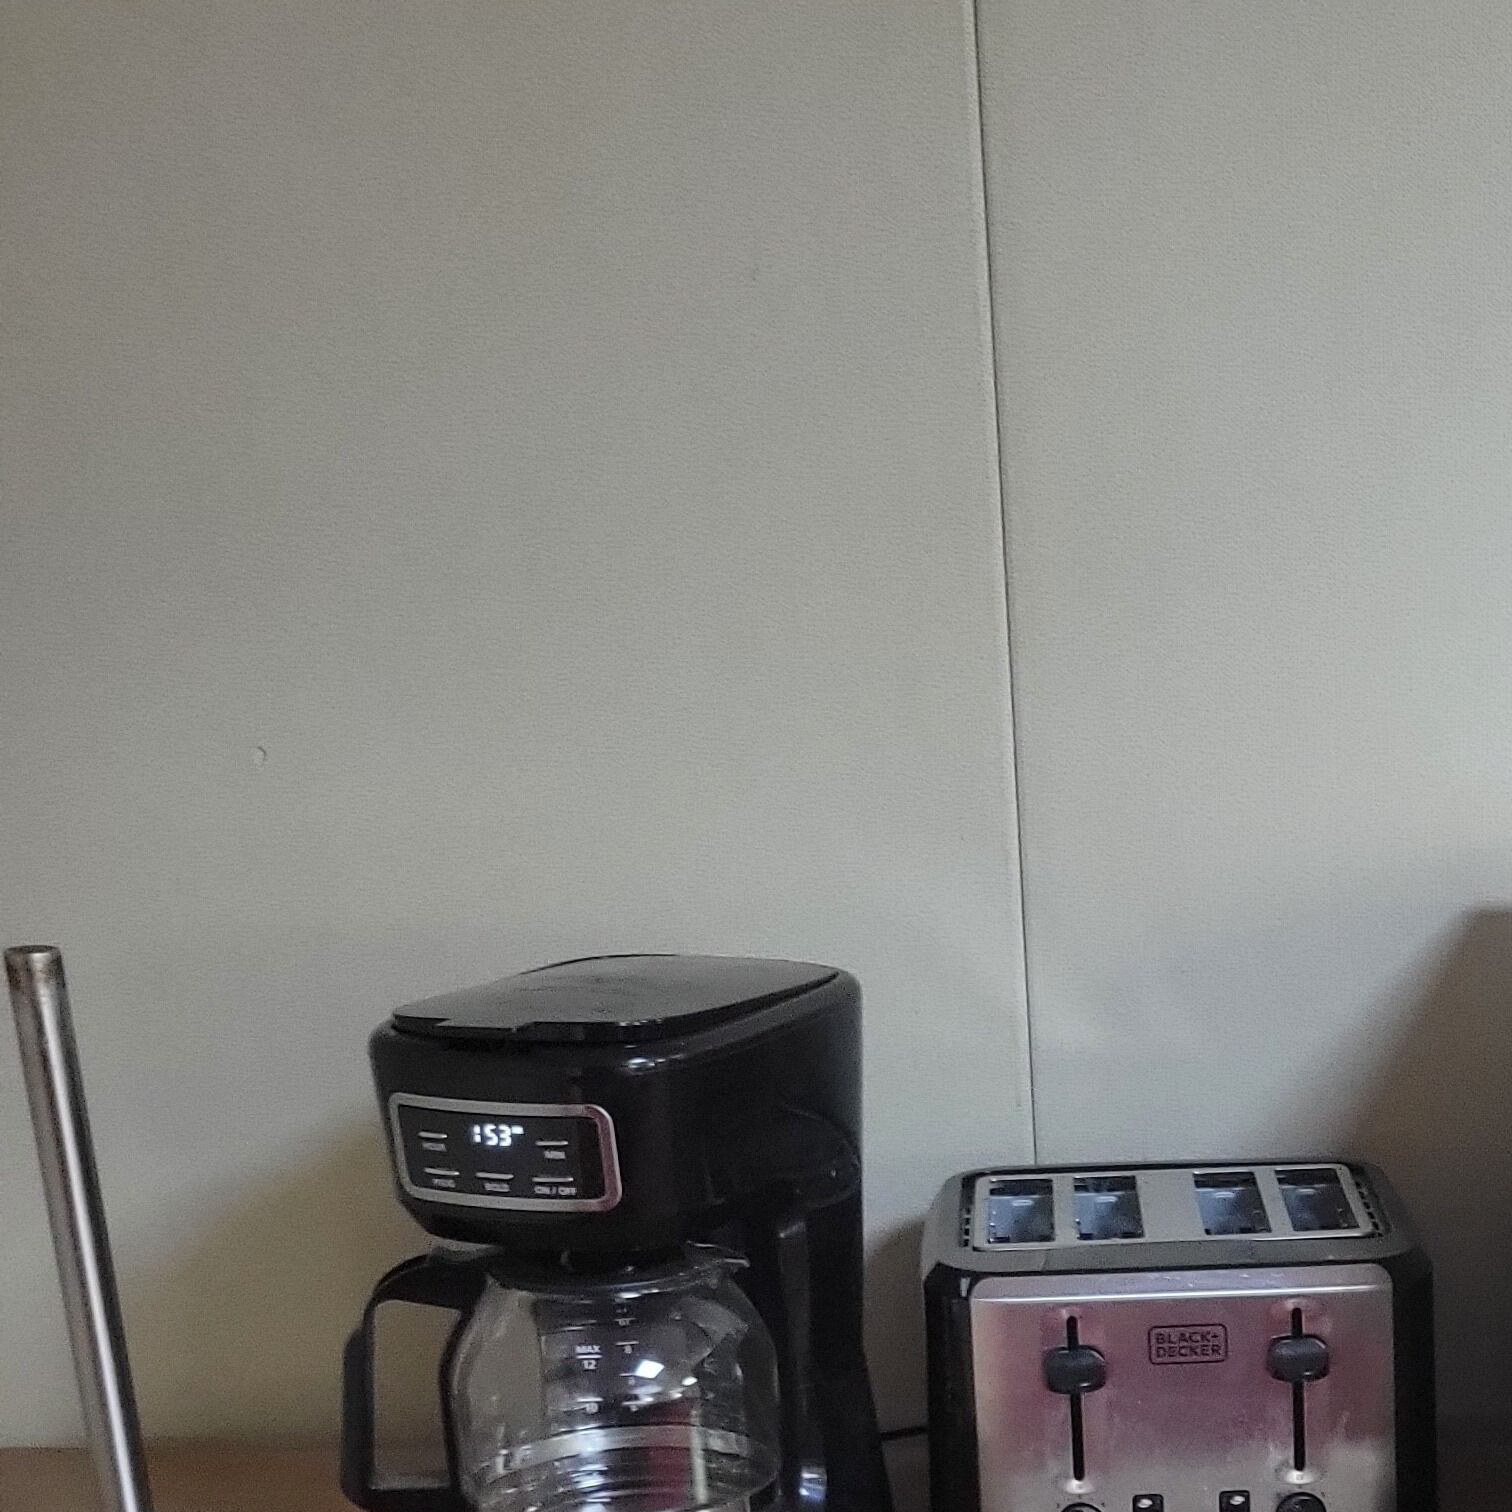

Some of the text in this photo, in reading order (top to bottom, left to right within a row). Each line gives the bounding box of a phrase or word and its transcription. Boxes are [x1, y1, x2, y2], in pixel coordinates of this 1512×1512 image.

[1155, 1330, 1219, 1345] BLACK+
[1156, 1344, 1221, 1358] DECKER
[582, 1359, 597, 1370] 12
